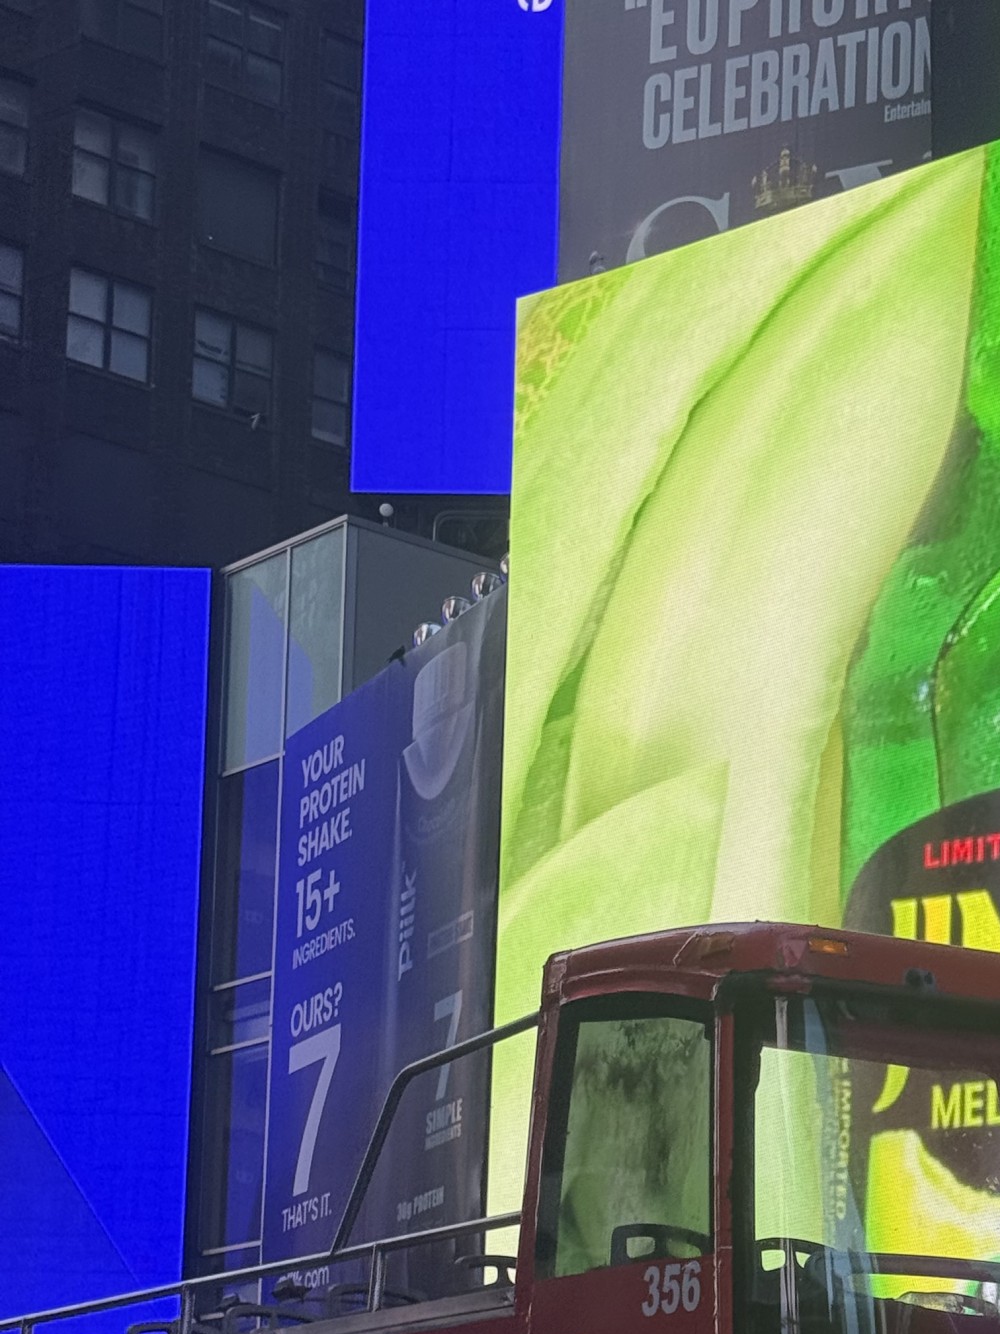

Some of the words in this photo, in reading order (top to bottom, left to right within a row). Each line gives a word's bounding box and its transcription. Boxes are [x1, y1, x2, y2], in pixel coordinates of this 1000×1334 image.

[302, 734, 345, 788] YOUR
[299, 758, 365, 829] PROTEIN
[295, 868, 341, 938] 15+
[290, 981, 343, 1038] OURS?
[289, 1023, 341, 1197] 7
[426, 1098, 463, 1135] SIMPLE
[281, 1196, 319, 1233] THAT'S
[320, 1192, 332, 1218] IT.
[641, 1260, 702, 1317] 356
